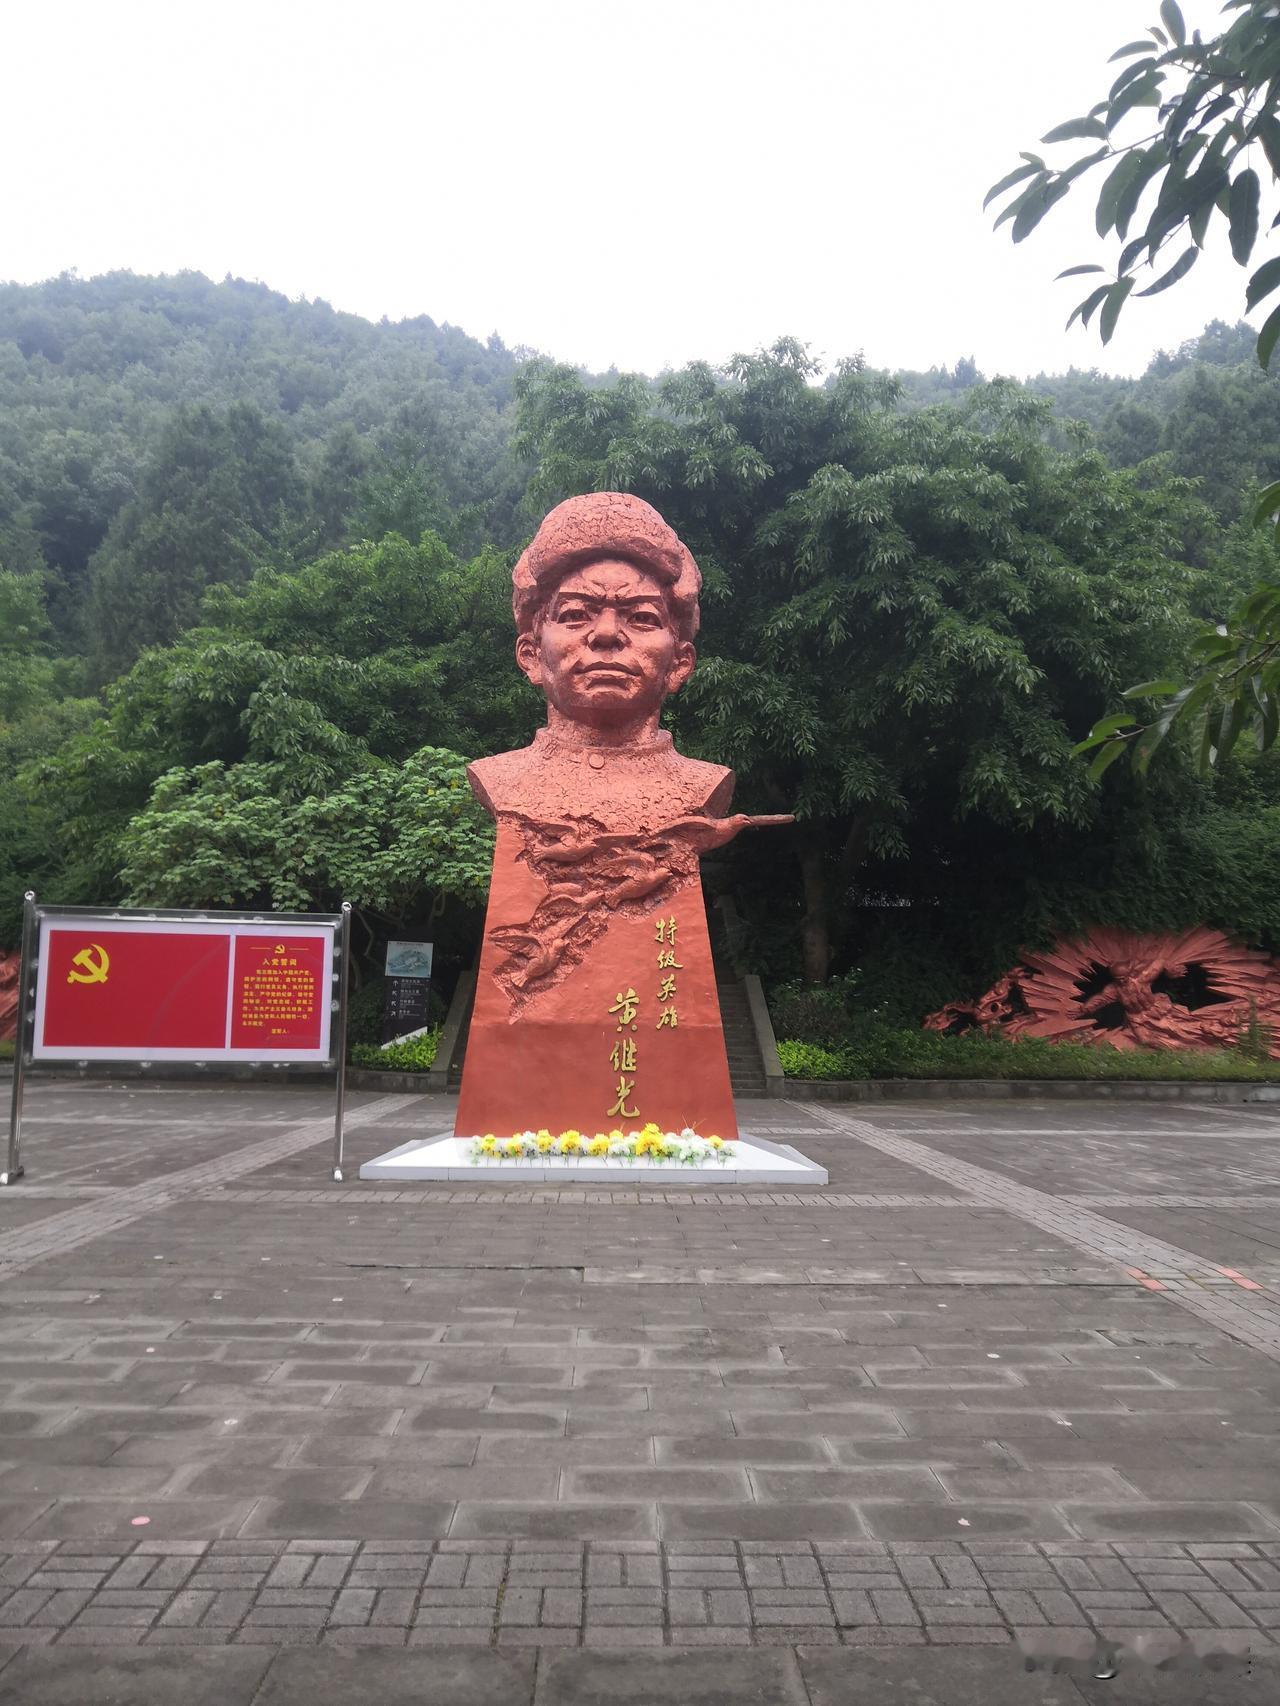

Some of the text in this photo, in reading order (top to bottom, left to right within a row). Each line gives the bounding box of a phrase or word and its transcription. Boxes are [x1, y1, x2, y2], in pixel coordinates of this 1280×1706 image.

[654, 915, 683, 1030] 特级英雄
[607, 986, 641, 1119] 黄继光
